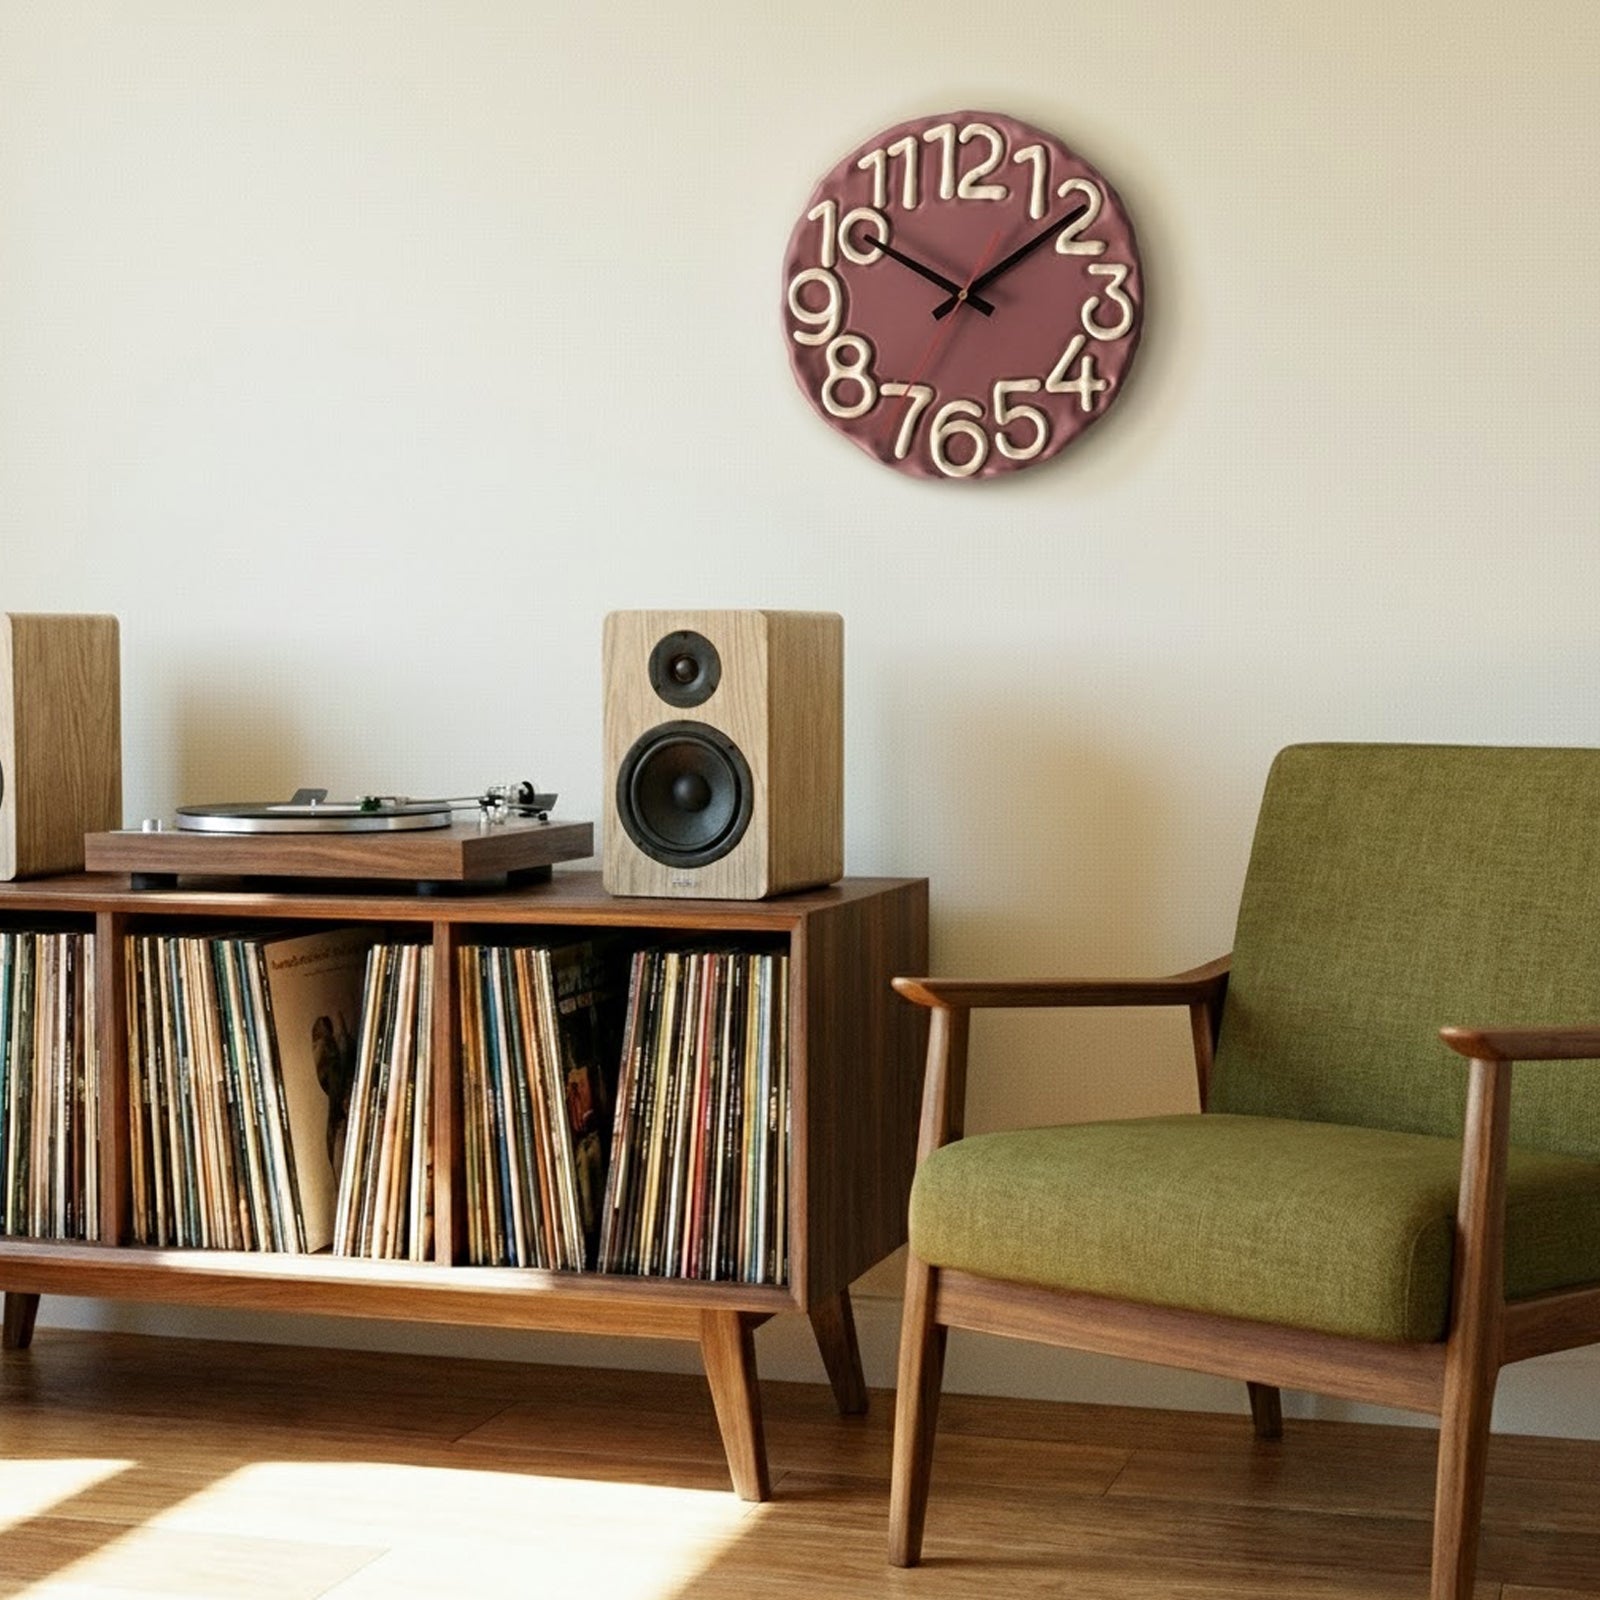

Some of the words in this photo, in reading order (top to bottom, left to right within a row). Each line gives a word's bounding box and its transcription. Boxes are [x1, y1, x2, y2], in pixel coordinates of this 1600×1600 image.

[858, 136, 918, 210] 11
[923, 123, 1008, 200] 12
[1014, 144, 1046, 219] 1
[808, 200, 890, 268] 10
[1056, 178, 1106, 255] 2
[789, 268, 842, 345] 9
[1081, 264, 1133, 340] 3
[822, 333, 876, 418] 8
[1045, 334, 1107, 411] 4
[880, 382, 934, 458] 7
[930, 400, 988, 477] 6
[993, 378, 1047, 460] 5
